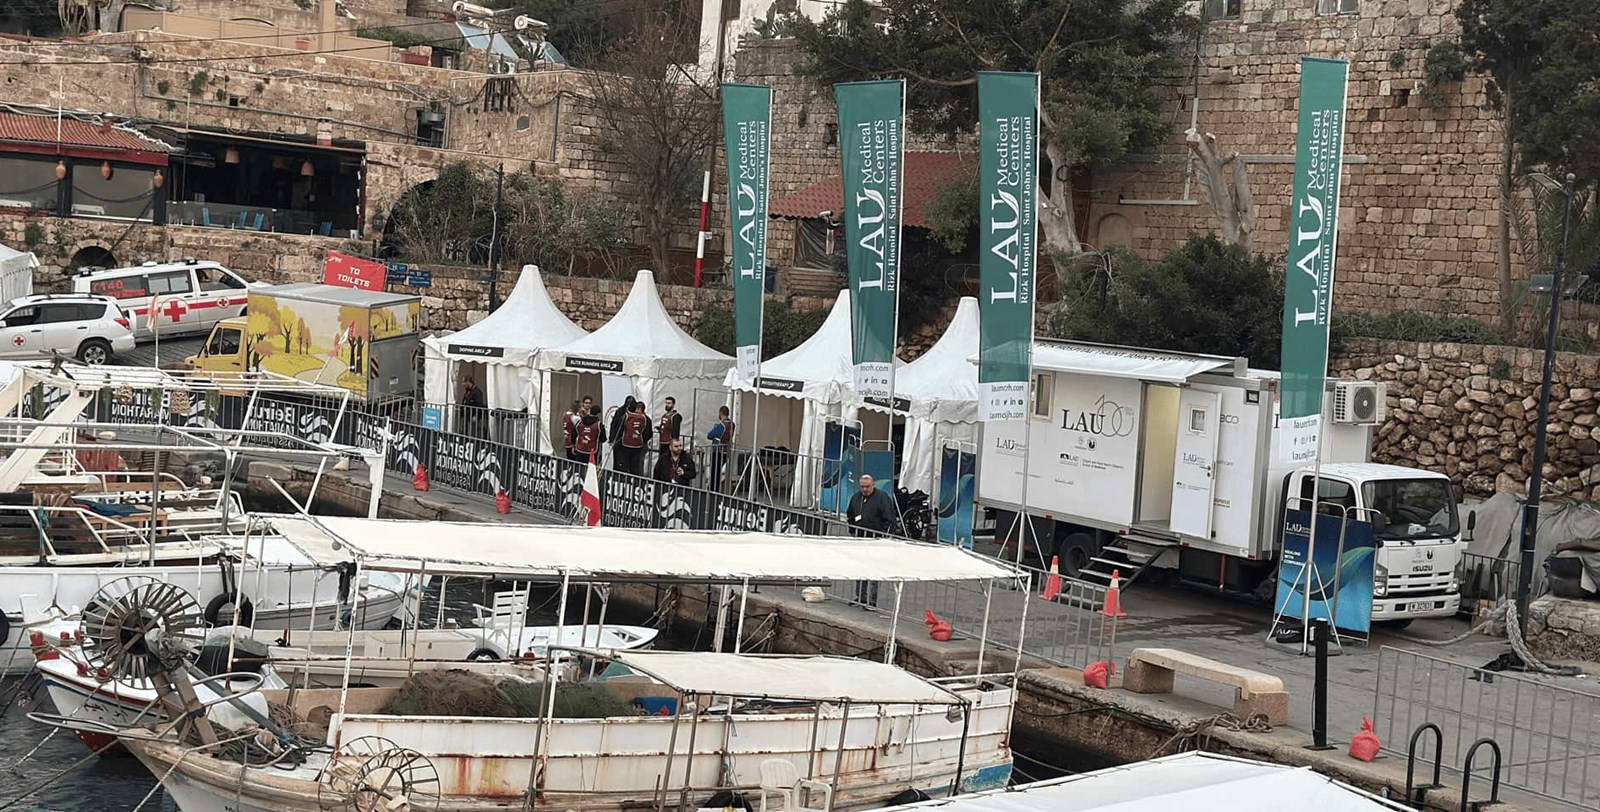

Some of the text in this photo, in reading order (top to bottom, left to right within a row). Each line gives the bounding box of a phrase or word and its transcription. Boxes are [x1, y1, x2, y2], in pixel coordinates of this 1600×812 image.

[738, 122, 748, 179] Medical
[747, 120, 756, 179] Centers
[759, 121, 767, 157] Hospital
[857, 121, 873, 184] Medical
[873, 119, 885, 184] Centers
[888, 119, 898, 158] Hospital
[997, 118, 1008, 186] Medical
[1007, 116, 1020, 187] Centers
[1306, 110, 1322, 190] Medical
[1316, 109, 1330, 190] Centers
[888, 161, 897, 193] John's
[888, 195, 897, 219] Saint
[737, 182, 757, 281] LAU
[856, 187, 886, 292] LAU
[1020, 116, 1032, 304] Rizk Hospital Saint John's Hospital
[1318, 109, 1341, 325] Rizk Hospital Saint John's Hospital
[349, 266, 361, 276] TO
[991, 188, 1019, 304] LAU
[1295, 193, 1324, 328] LAU
[337, 273, 371, 288] TOILETS
[887, 269, 896, 291] Rizk
[996, 437, 1015, 450] LAU
[1061, 409, 1106, 434] LAU
[1286, 522, 1302, 533] LAU
